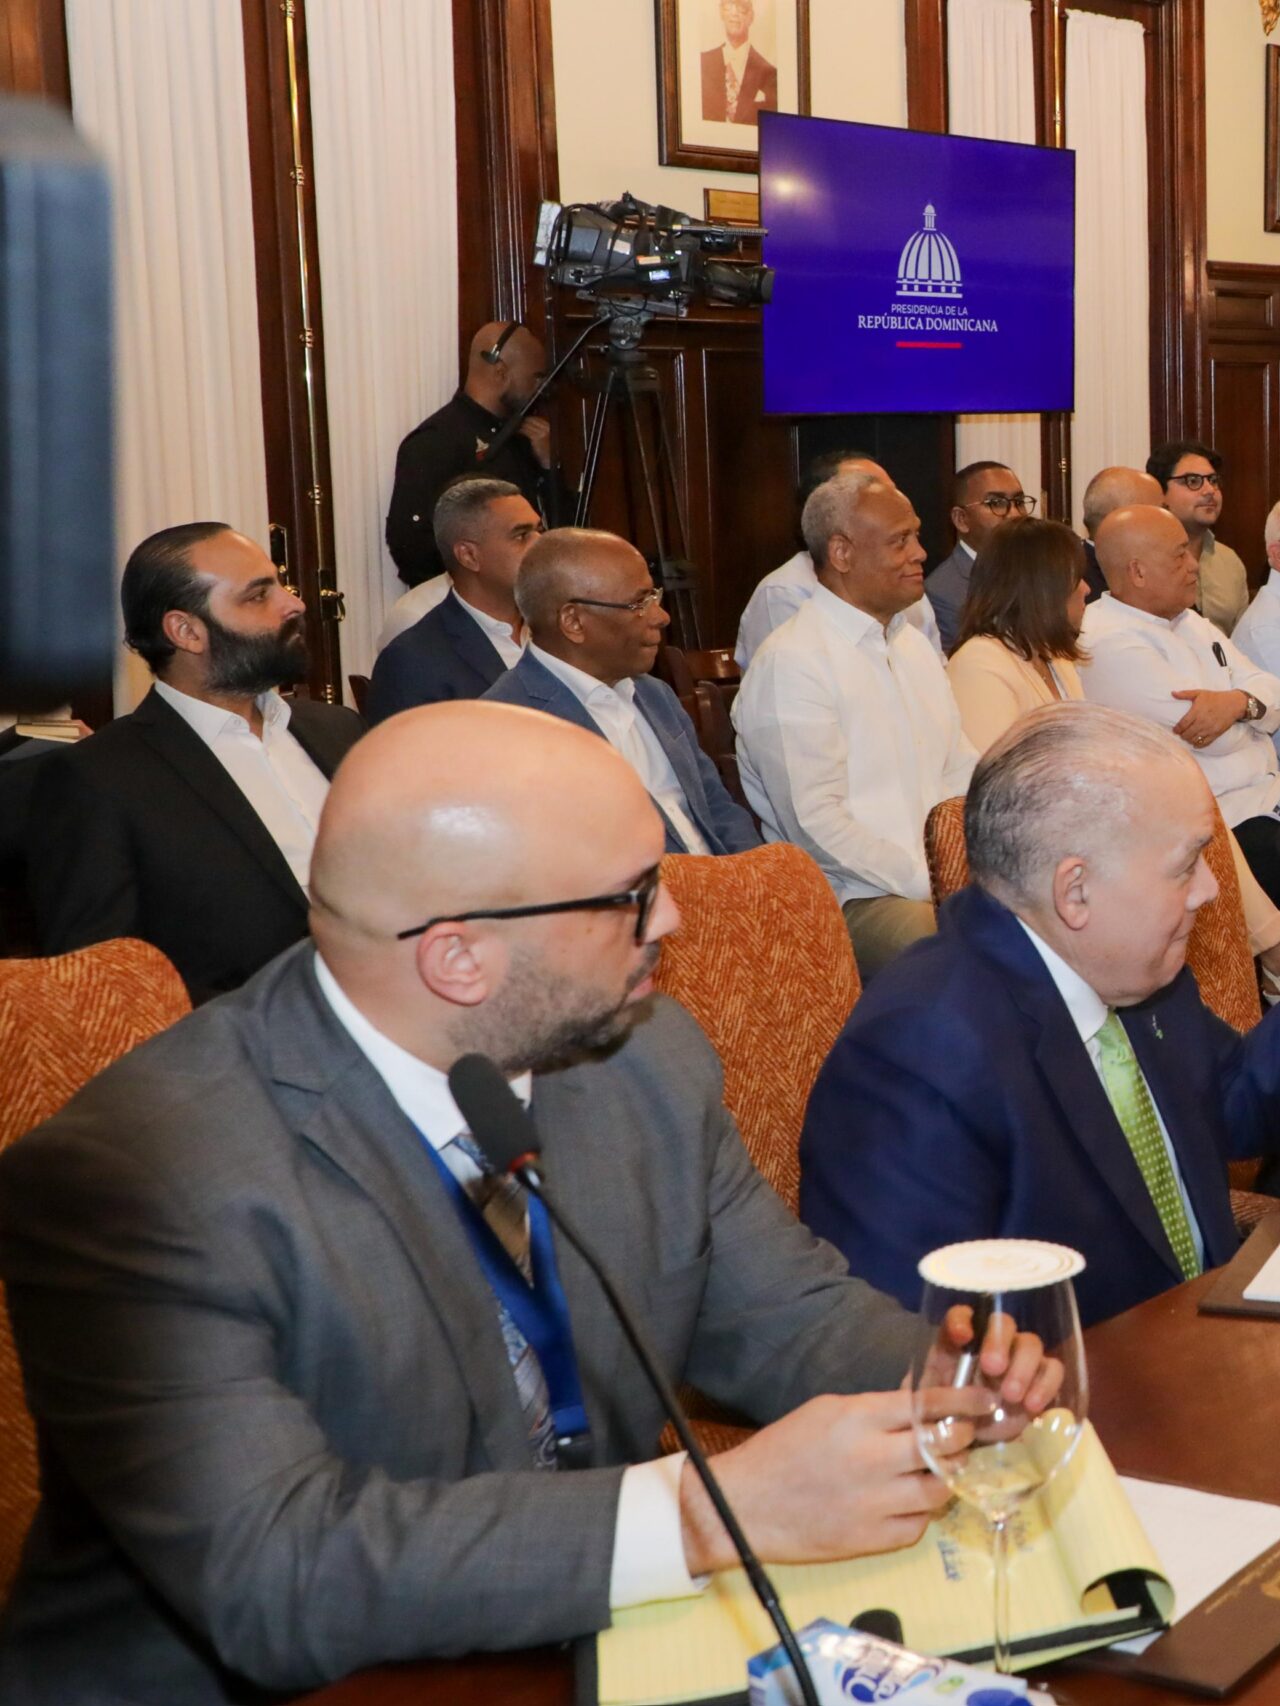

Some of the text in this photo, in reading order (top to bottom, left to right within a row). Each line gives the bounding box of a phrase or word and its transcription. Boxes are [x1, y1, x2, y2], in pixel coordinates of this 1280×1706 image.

[891, 304, 968, 316] PRESIDENCIA DE LA
[858, 312, 999, 332] REPÚBLICA DOMINICANA
